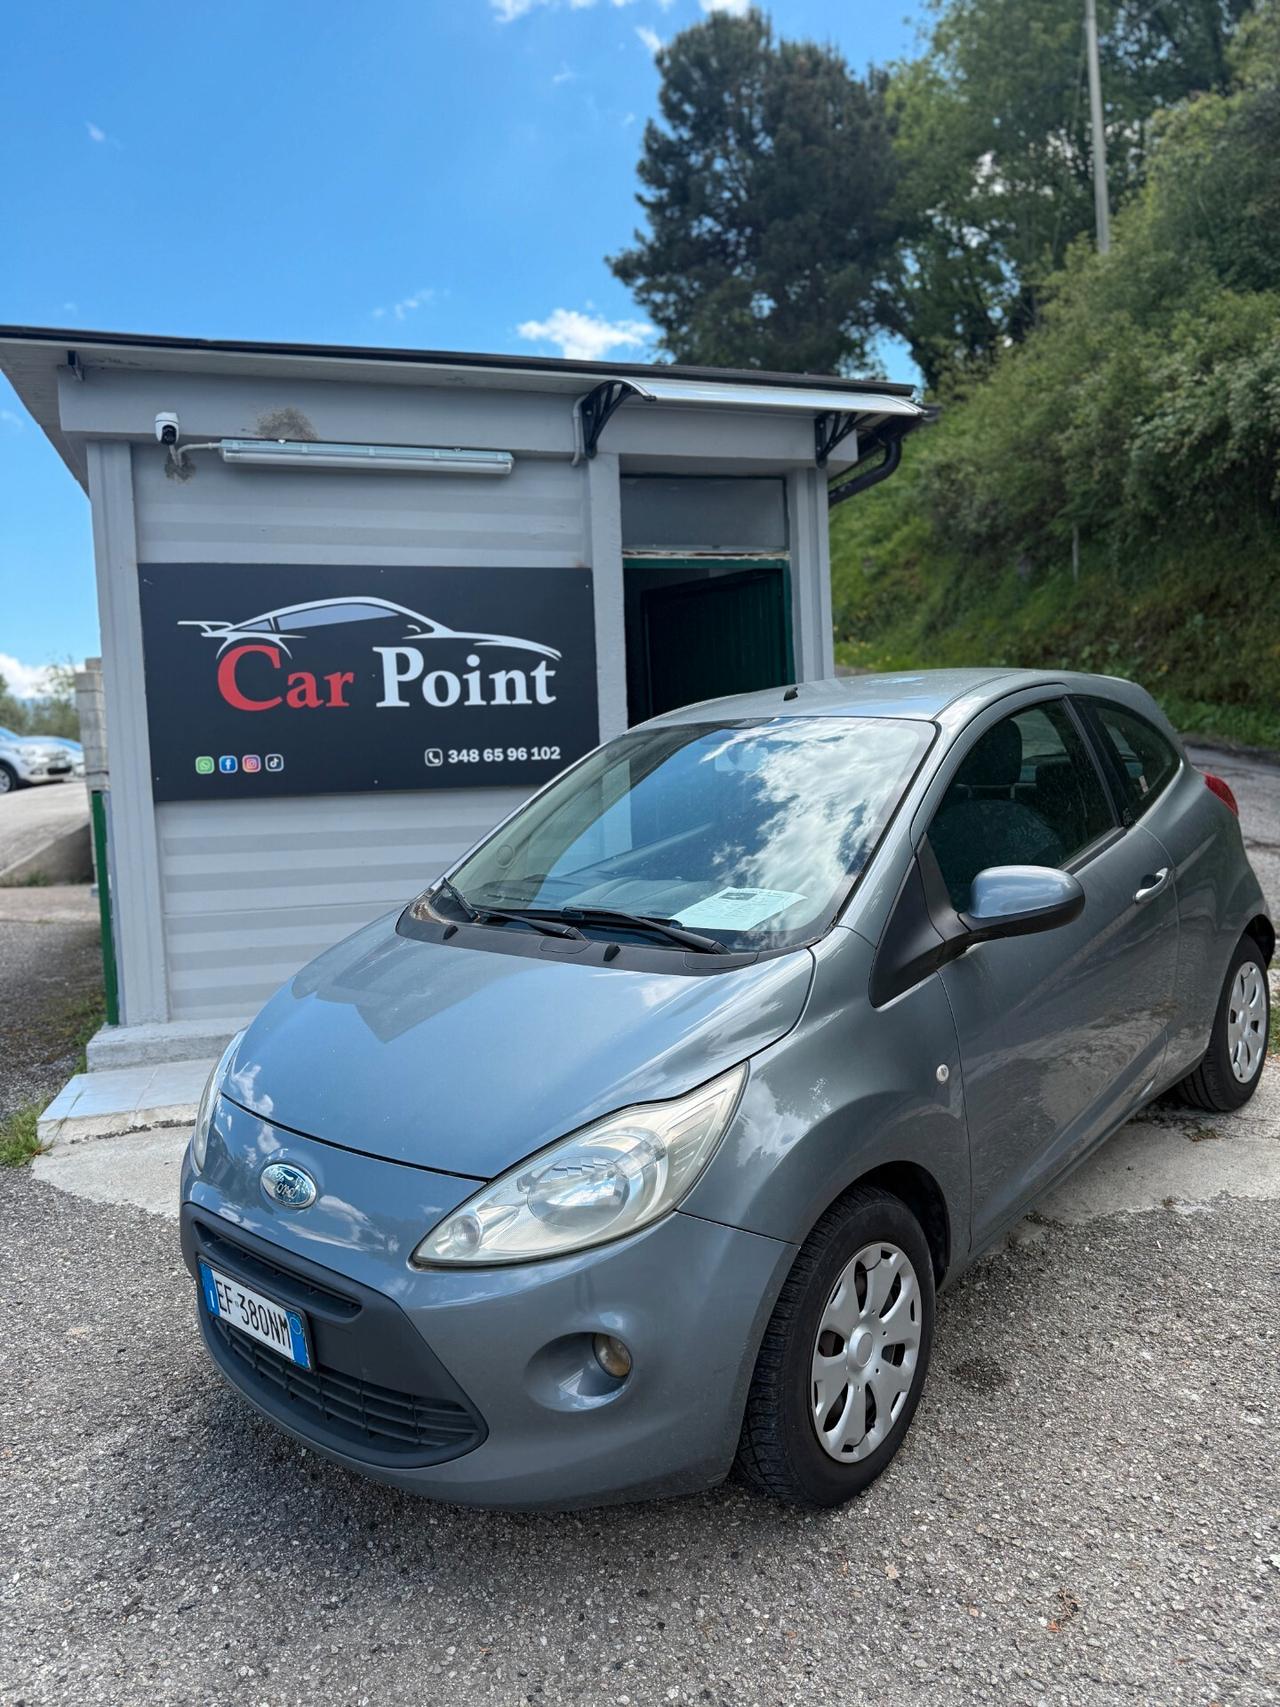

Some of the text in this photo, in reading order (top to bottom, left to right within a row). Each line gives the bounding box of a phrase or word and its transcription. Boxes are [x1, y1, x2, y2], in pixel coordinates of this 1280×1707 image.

[217, 644, 557, 711] Car Point
[447, 746, 561, 763] 348 65 96 102
[215, 1280, 292, 1349] EF 380NM
